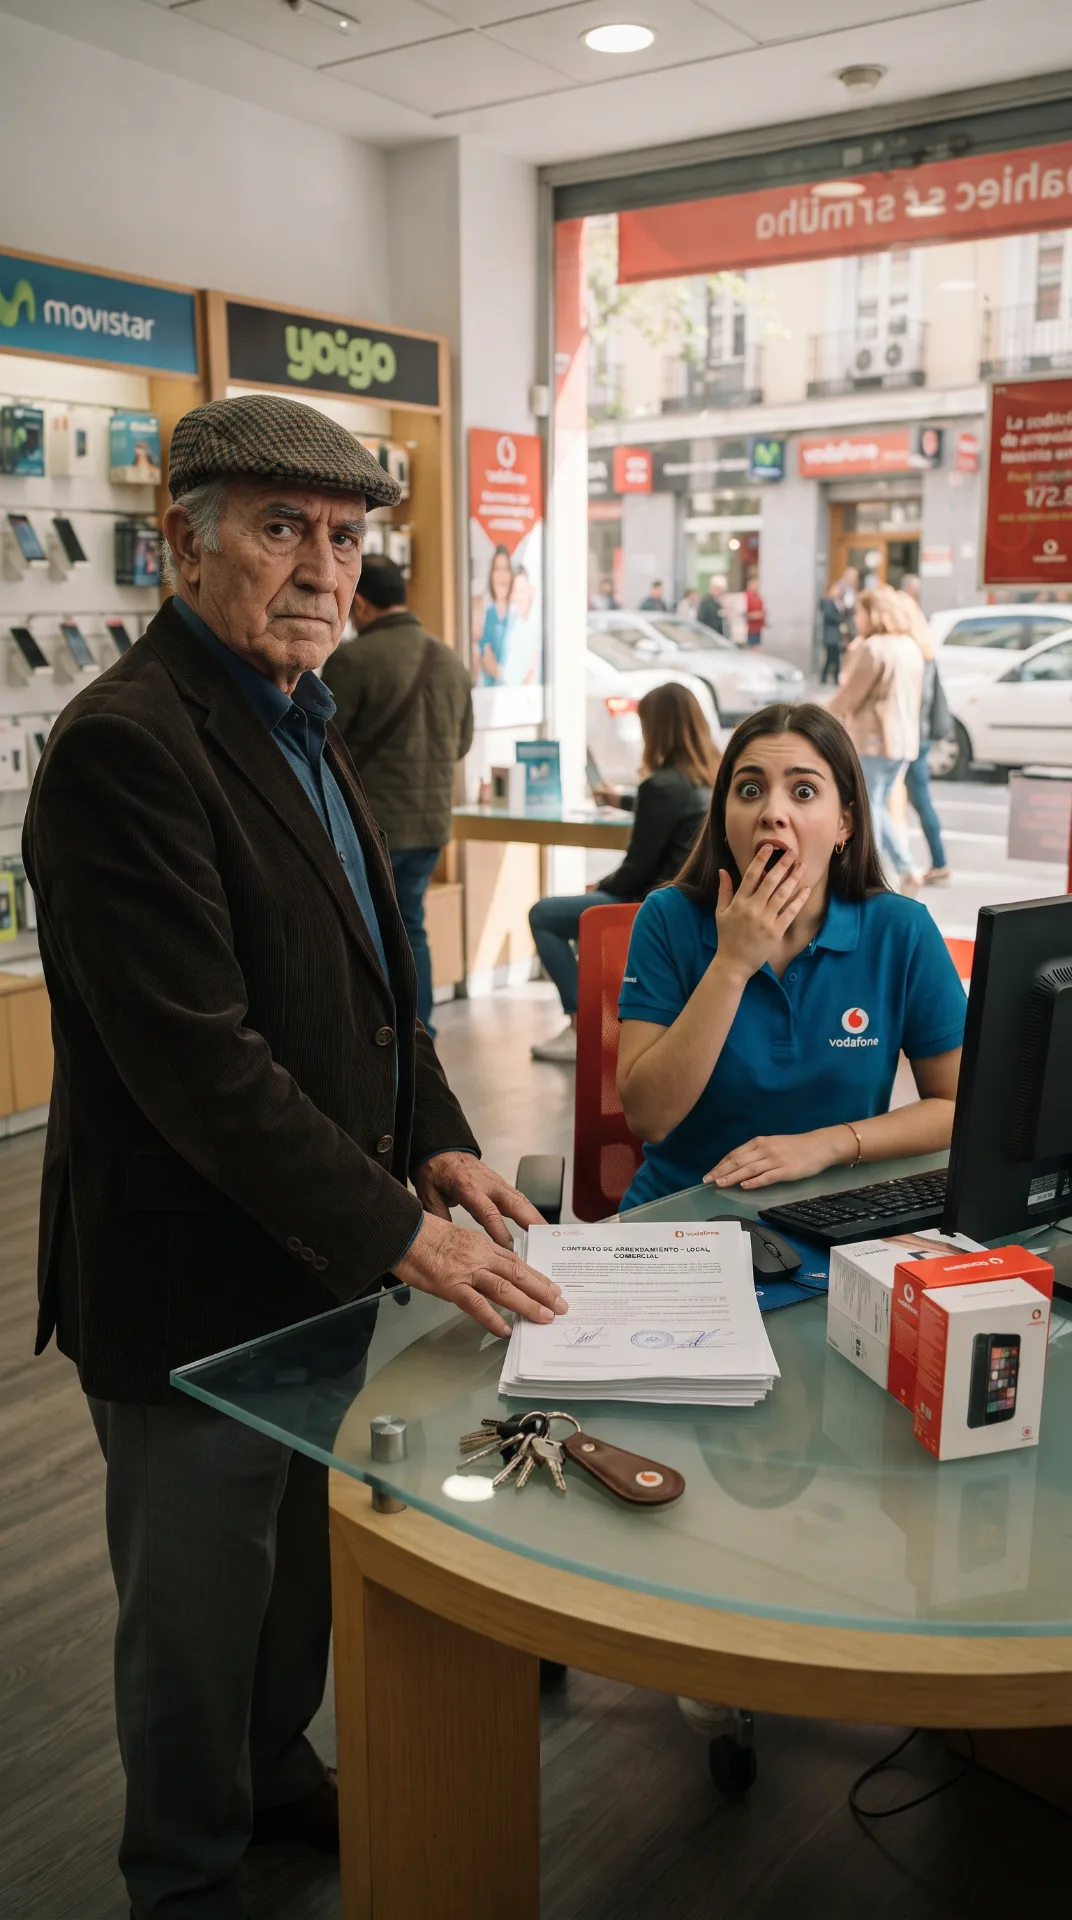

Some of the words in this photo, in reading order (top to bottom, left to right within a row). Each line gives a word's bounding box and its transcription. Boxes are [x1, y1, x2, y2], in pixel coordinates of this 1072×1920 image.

[43, 299, 155, 341] movistar
[285, 325, 397, 390] yoigo
[828, 1036, 879, 1048] vodafone
